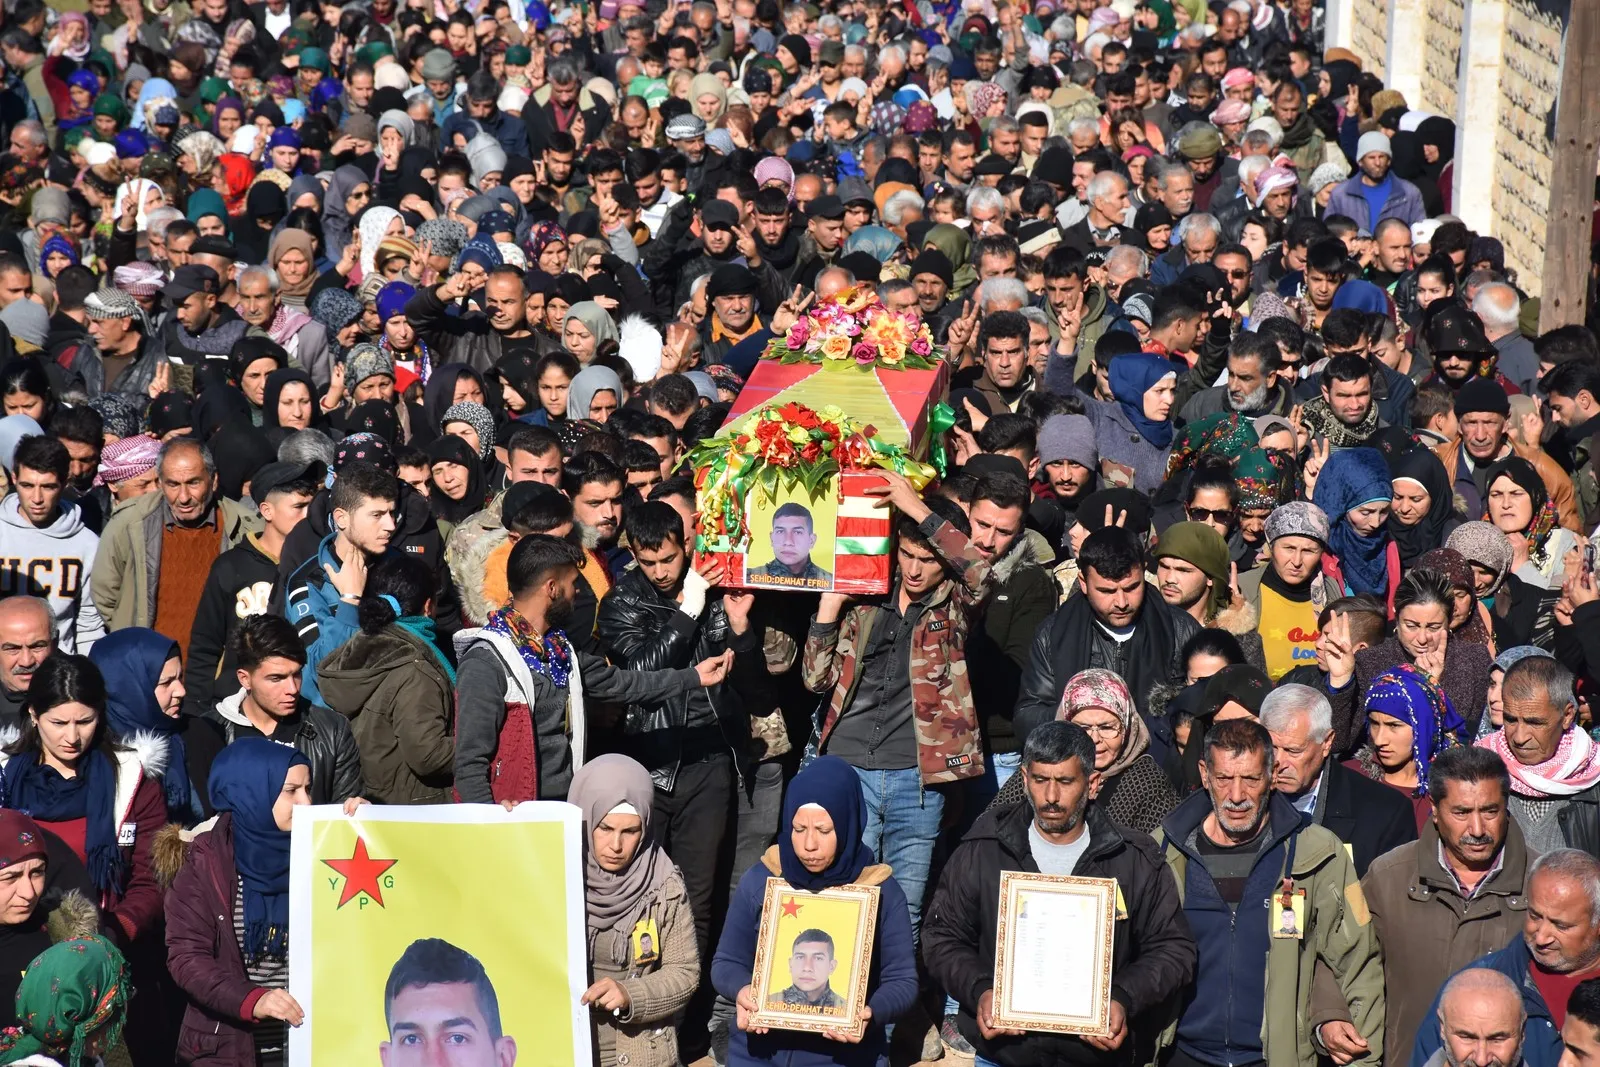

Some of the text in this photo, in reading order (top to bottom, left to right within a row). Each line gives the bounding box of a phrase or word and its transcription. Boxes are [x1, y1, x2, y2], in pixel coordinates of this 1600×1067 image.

[297, 603, 310, 616] D
[328, 875, 394, 910] Y P G
